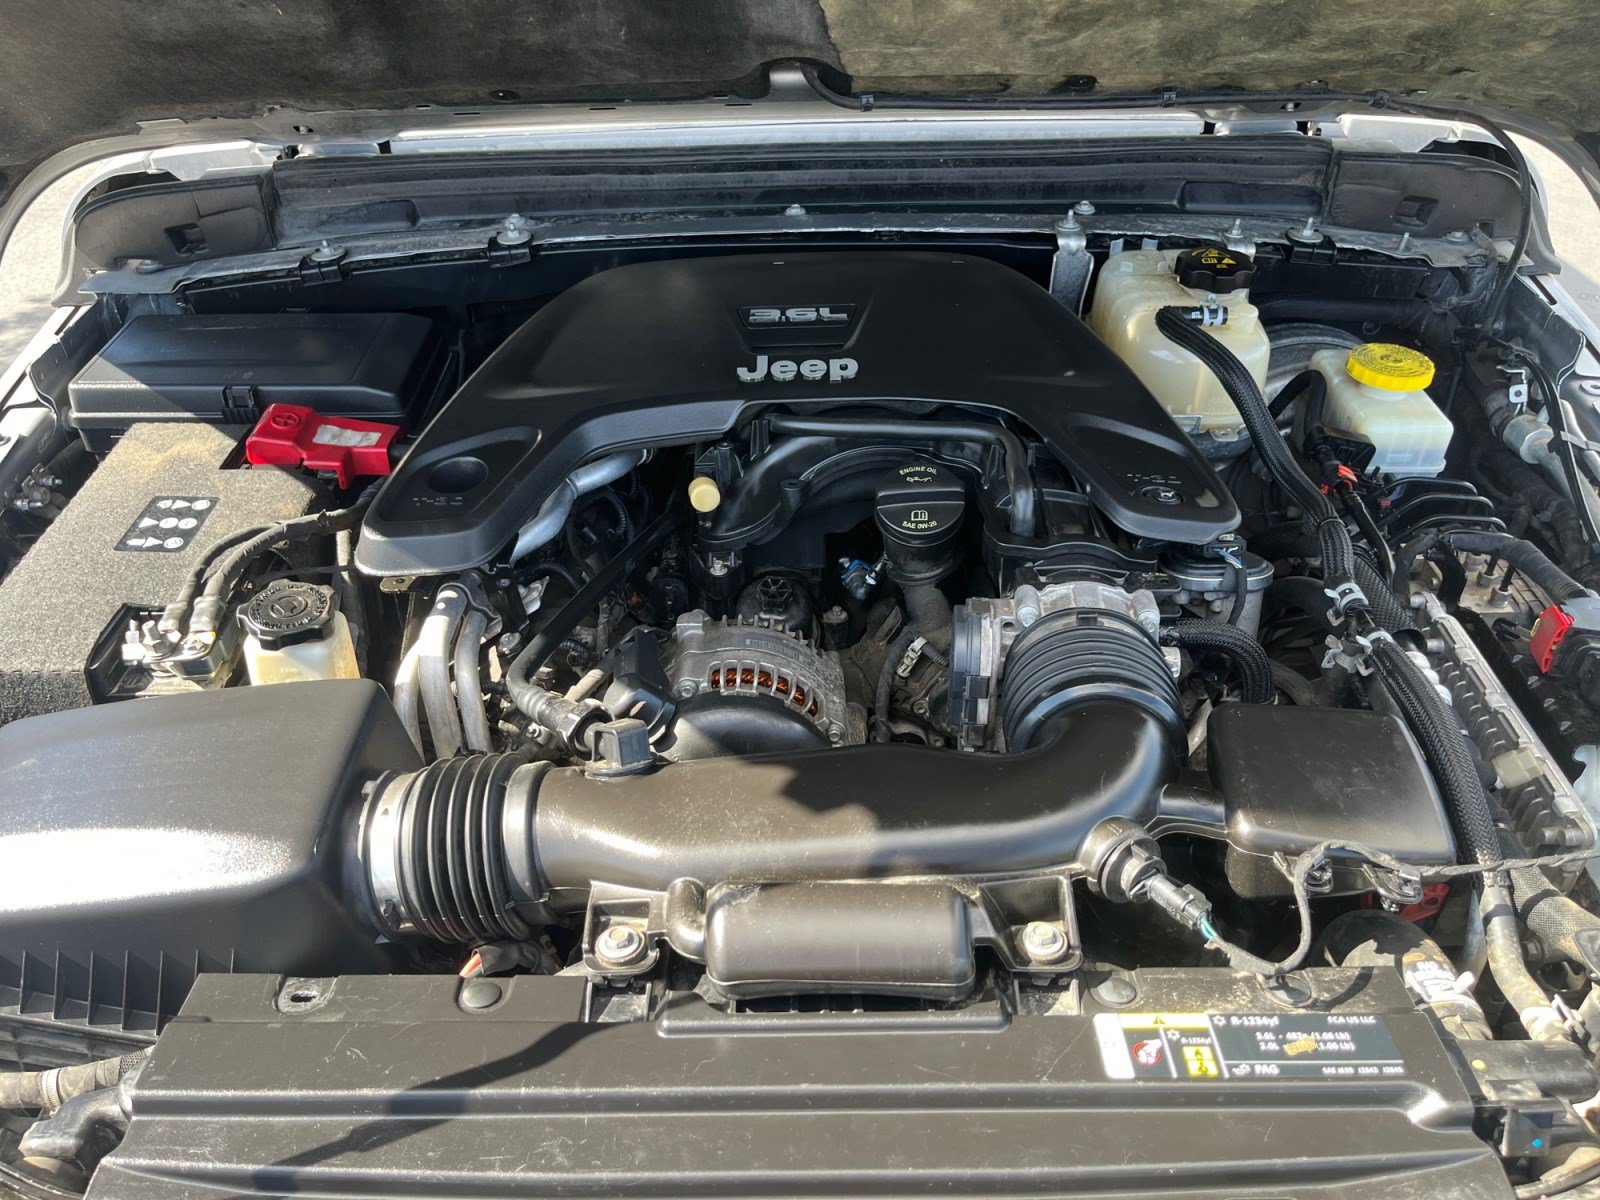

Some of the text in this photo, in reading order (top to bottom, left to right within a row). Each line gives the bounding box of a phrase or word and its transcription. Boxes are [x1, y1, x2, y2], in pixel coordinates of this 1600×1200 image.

[748, 307, 849, 323] 3.6L
[736, 355, 859, 384] Jeep
[899, 466, 938, 475] ENGINE OIL
[902, 520, 938, 529] SAE 0W-20
[1230, 1015, 1280, 1027] R-1234yf
[1327, 1015, 1376, 1025] FCA US LLC
[1259, 1041, 1279, 1050] 2.0L
[1254, 1063, 1280, 1075] PAG
